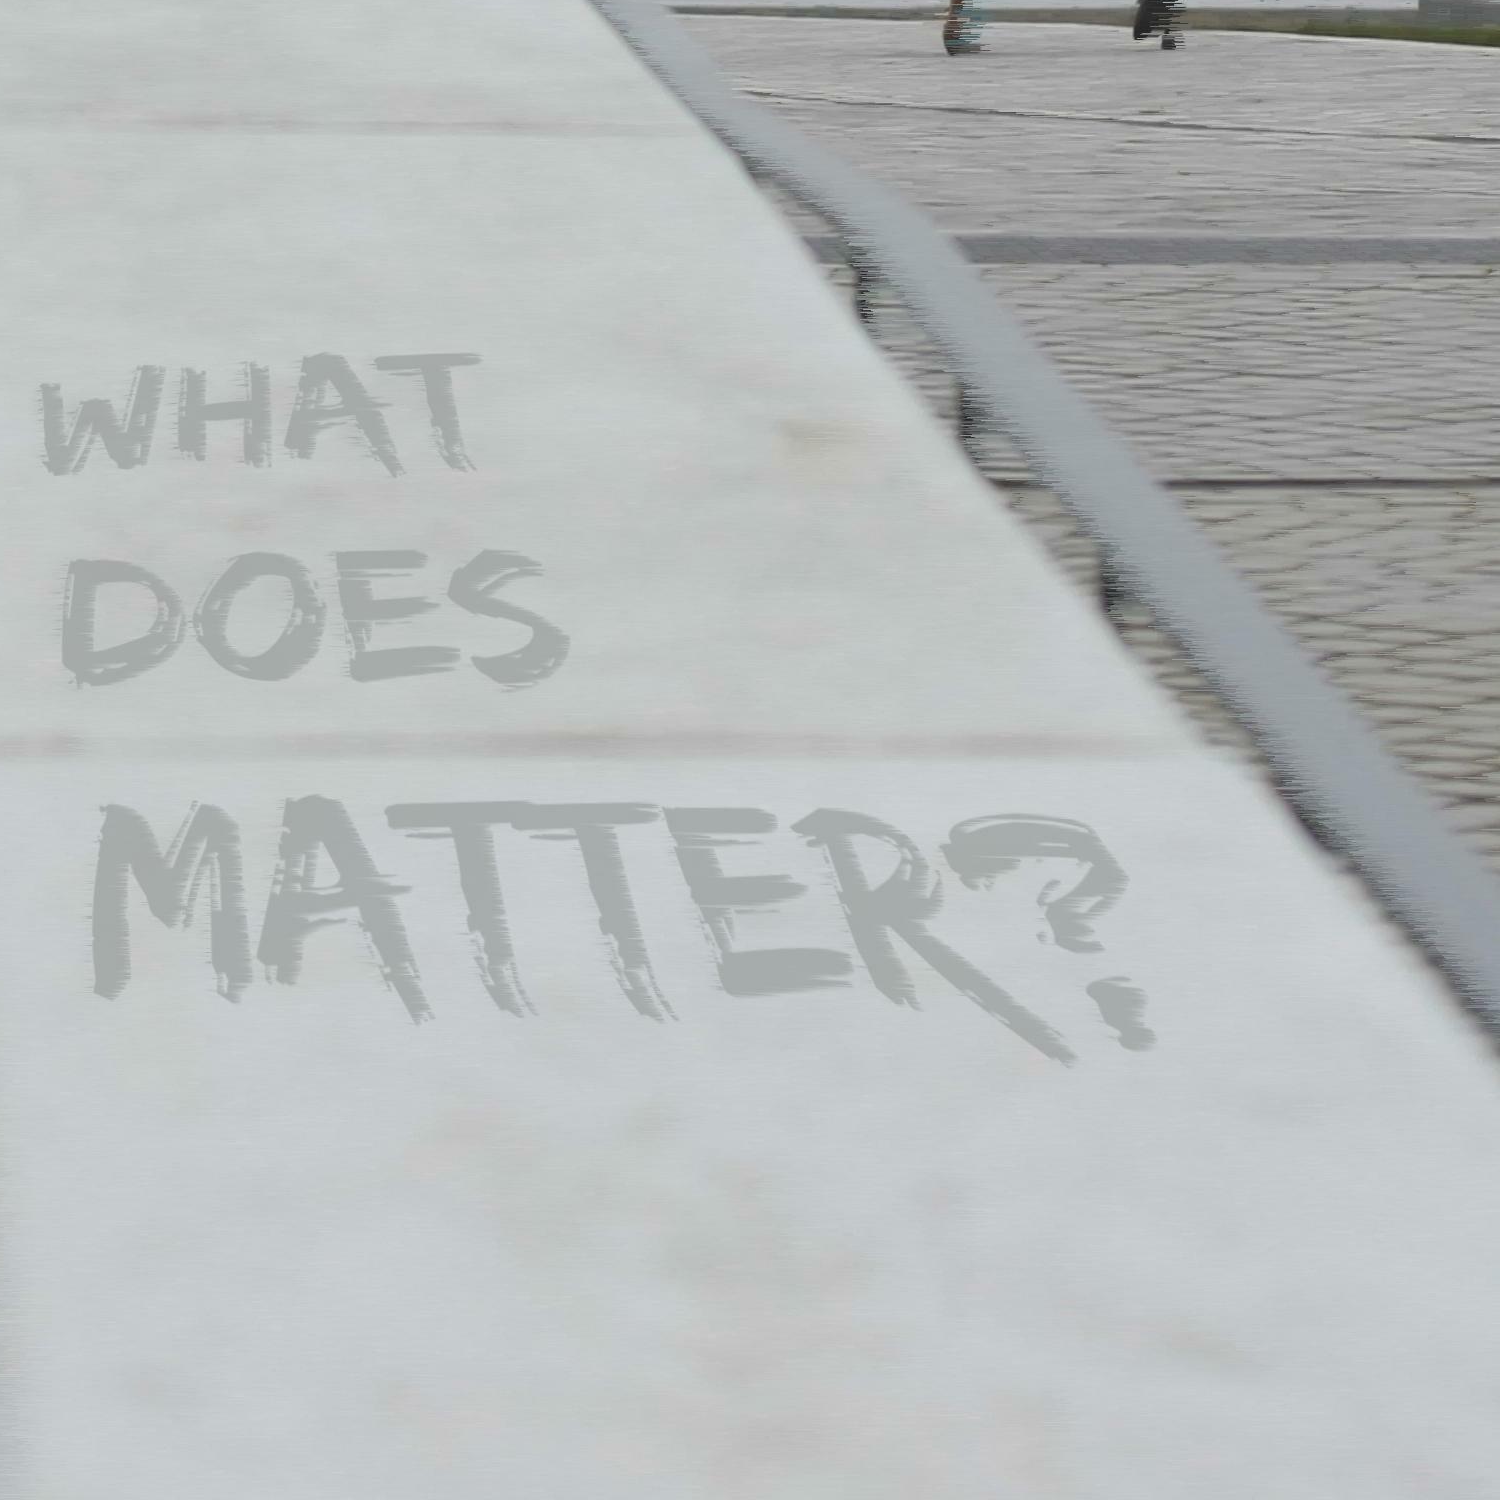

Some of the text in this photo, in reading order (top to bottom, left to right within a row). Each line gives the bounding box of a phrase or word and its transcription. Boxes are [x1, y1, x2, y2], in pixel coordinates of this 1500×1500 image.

[38, 353, 481, 478] WHAT
[61, 549, 569, 689] DOES
[92, 795, 1155, 1066] MATTER?
